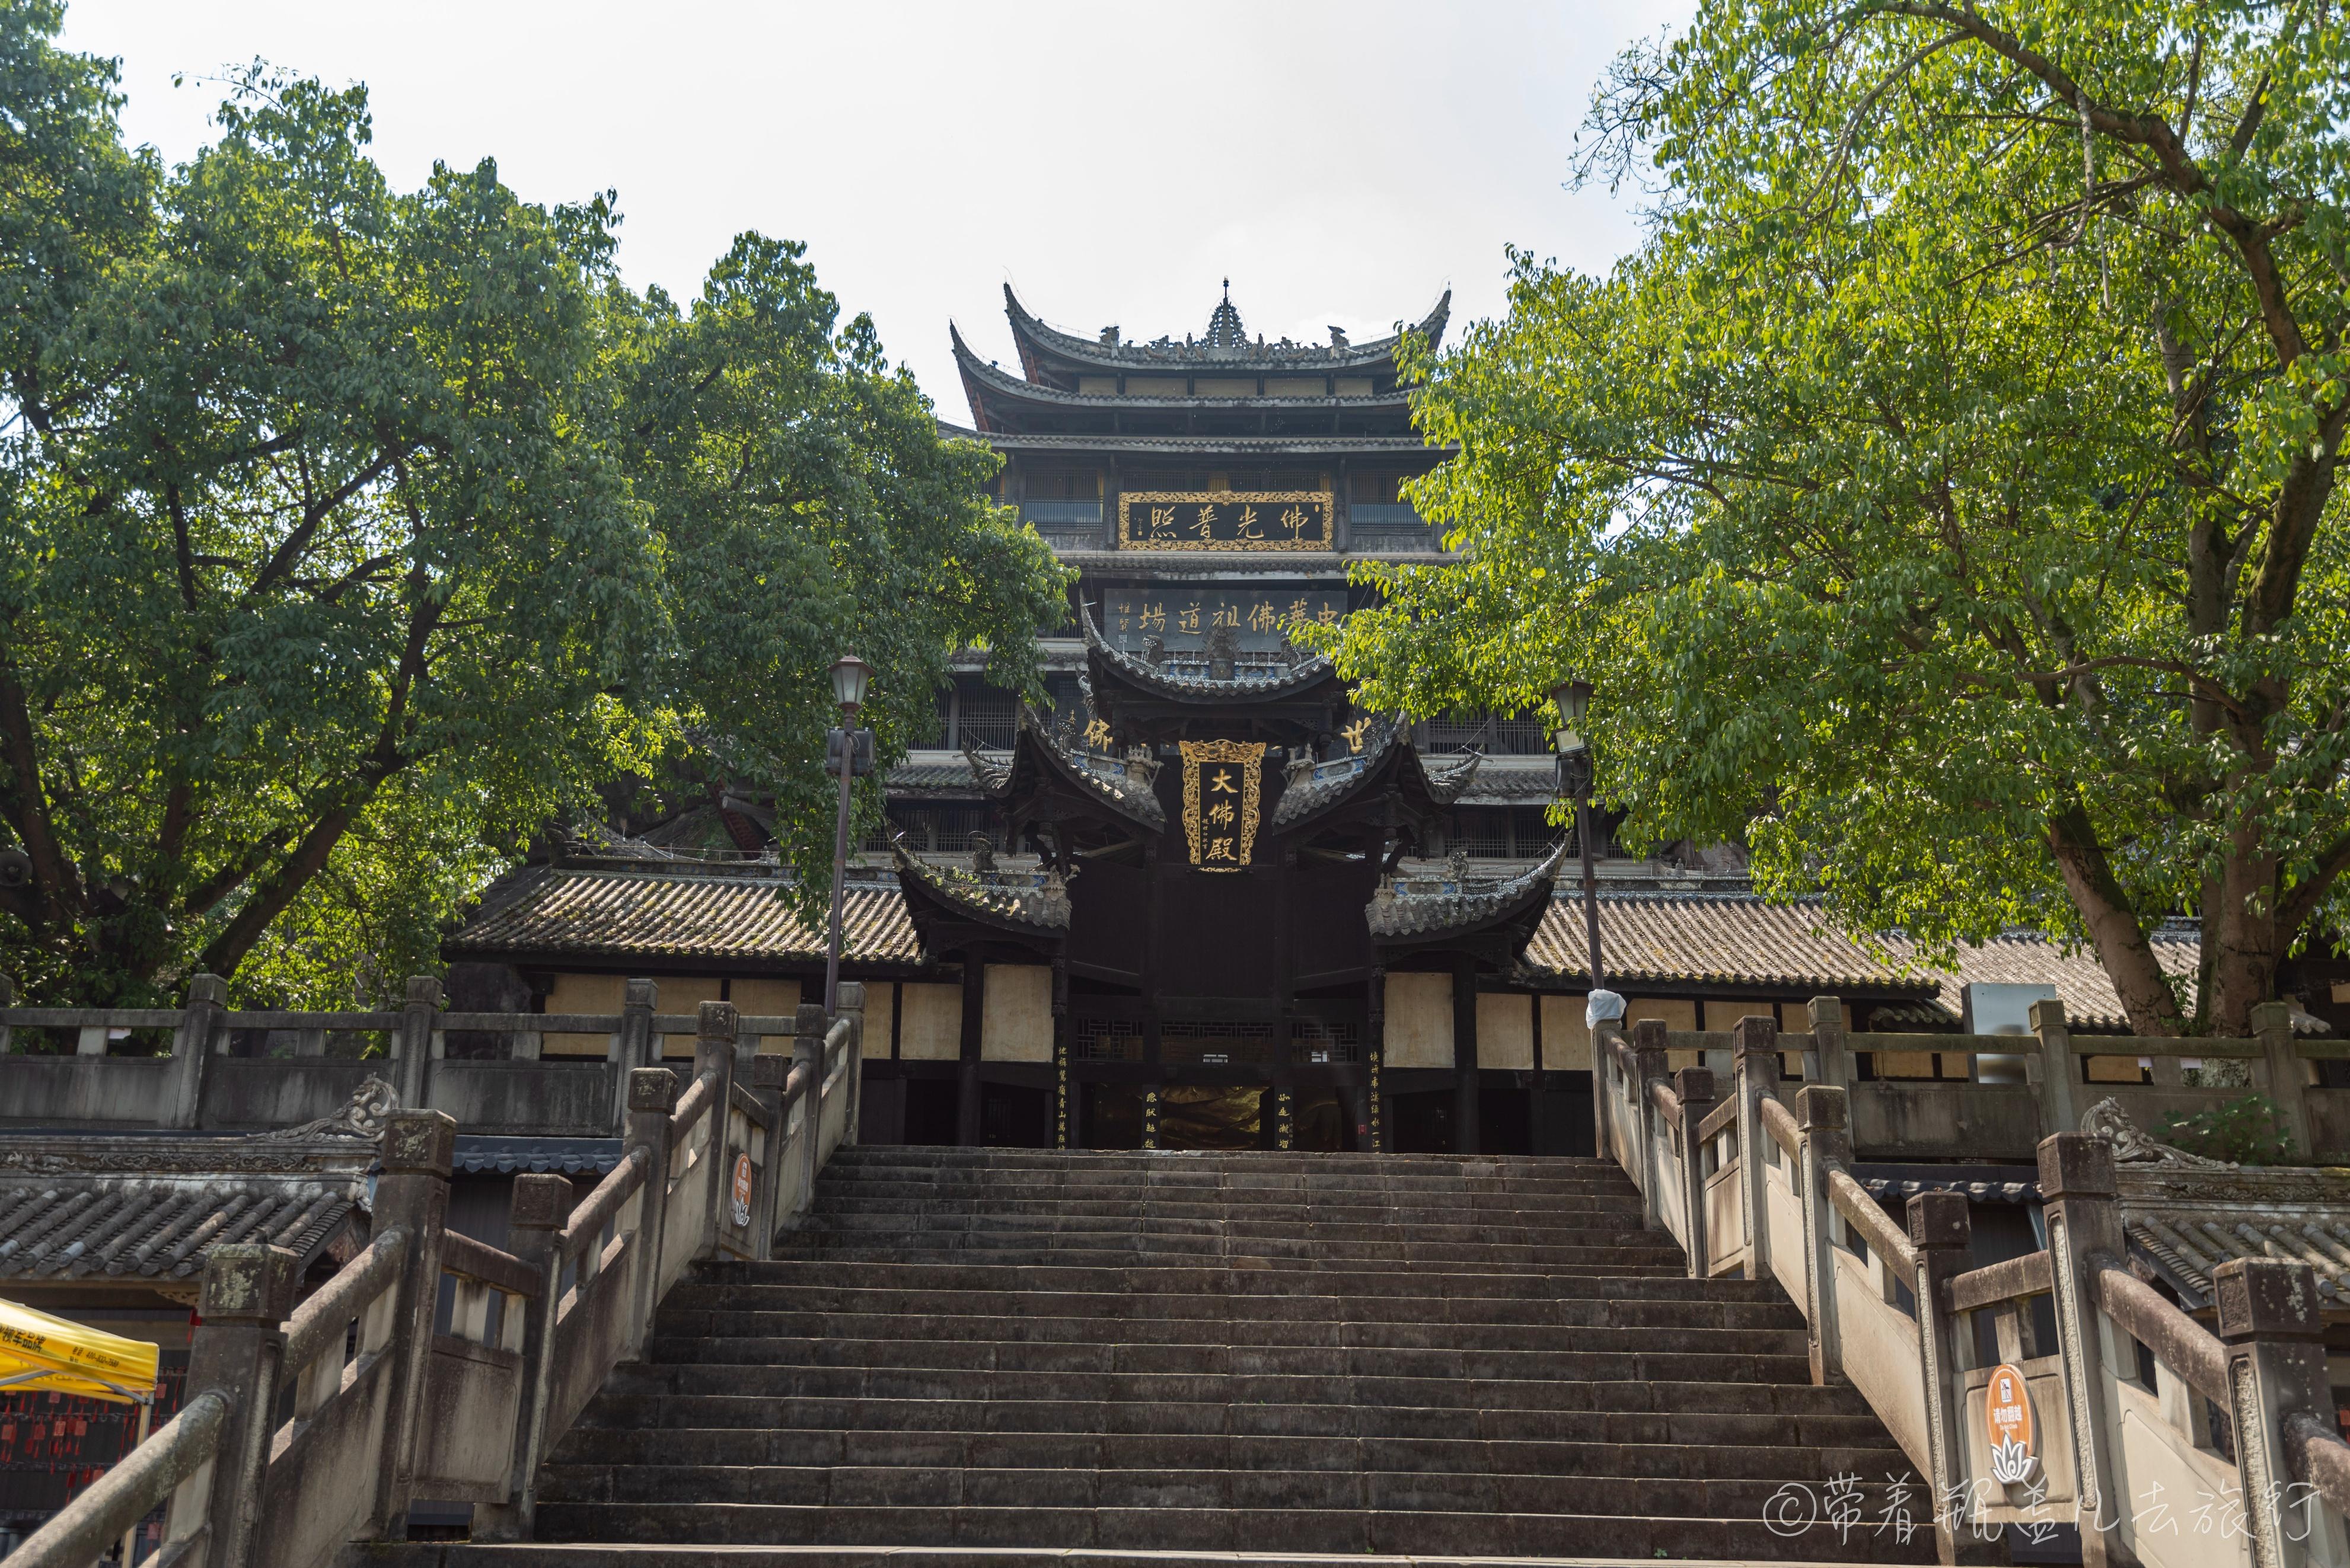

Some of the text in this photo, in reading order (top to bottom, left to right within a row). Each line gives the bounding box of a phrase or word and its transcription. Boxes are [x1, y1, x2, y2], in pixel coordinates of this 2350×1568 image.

[1205, 768, 1239, 860] 大佛殿
[1993, 1405, 2023, 1423] 请勿翻越
